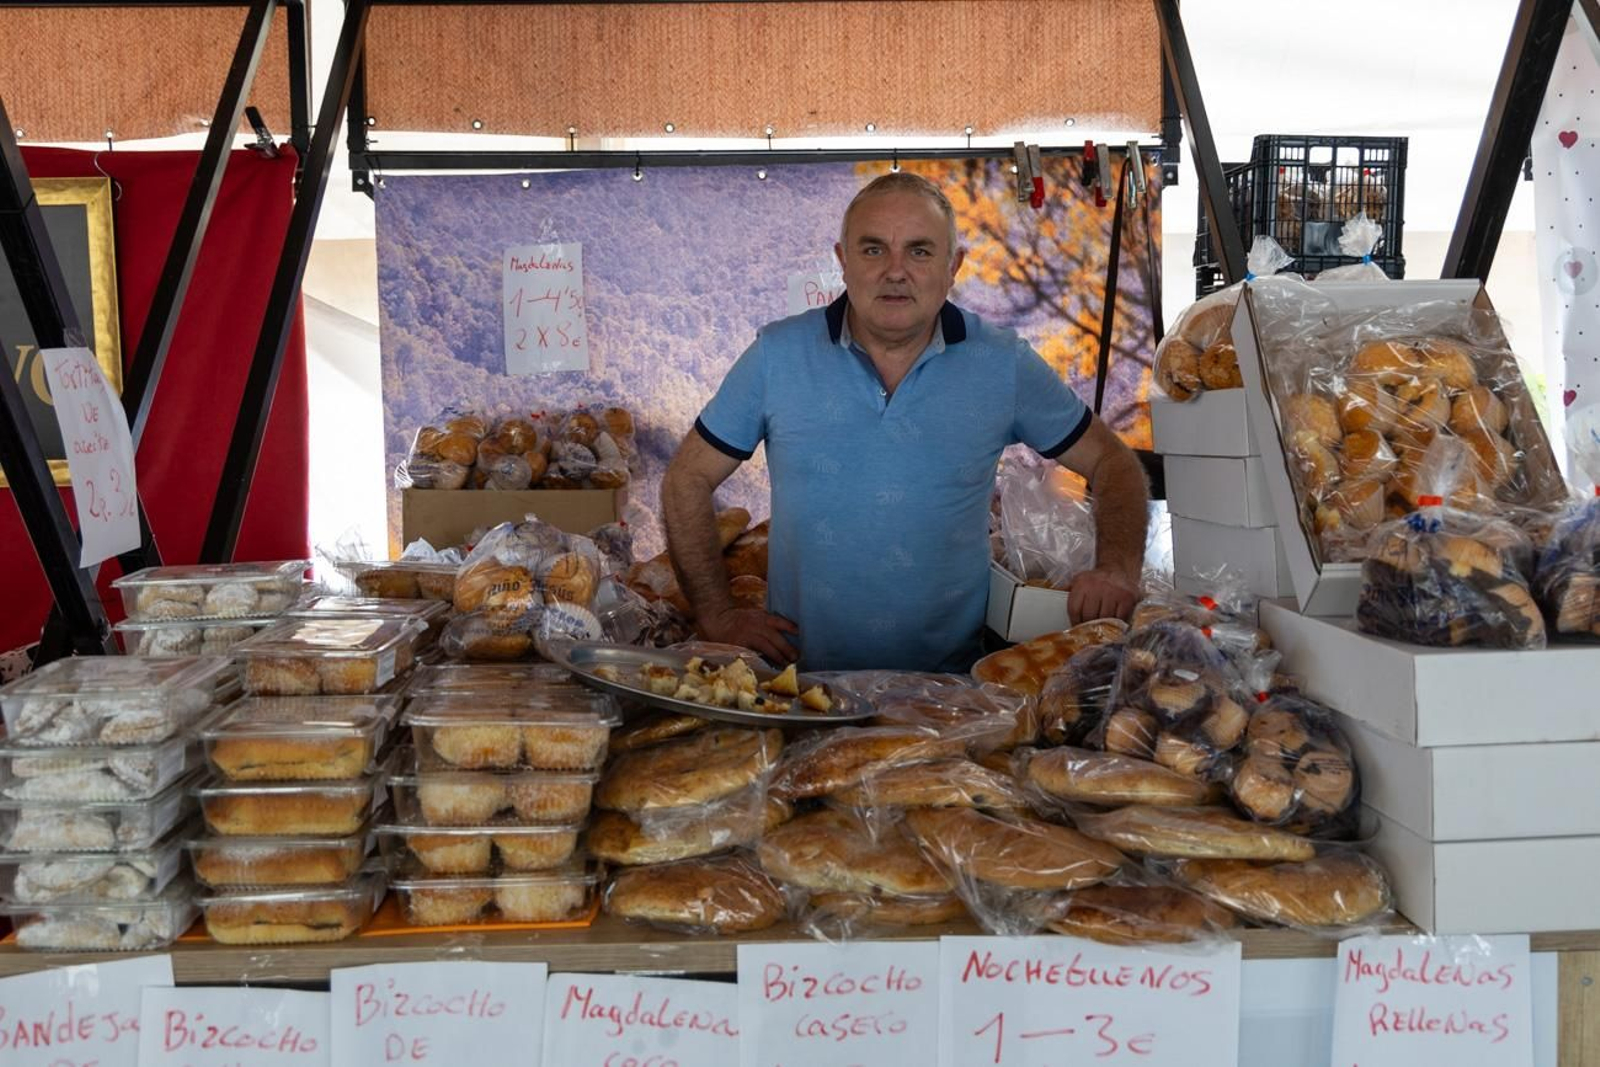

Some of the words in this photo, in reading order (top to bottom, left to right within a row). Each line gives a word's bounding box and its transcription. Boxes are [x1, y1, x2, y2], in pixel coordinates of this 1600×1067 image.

[515, 328, 528, 350] 2
[385, 1032, 431, 1063] DE
[974, 1012, 1004, 1063] 1
